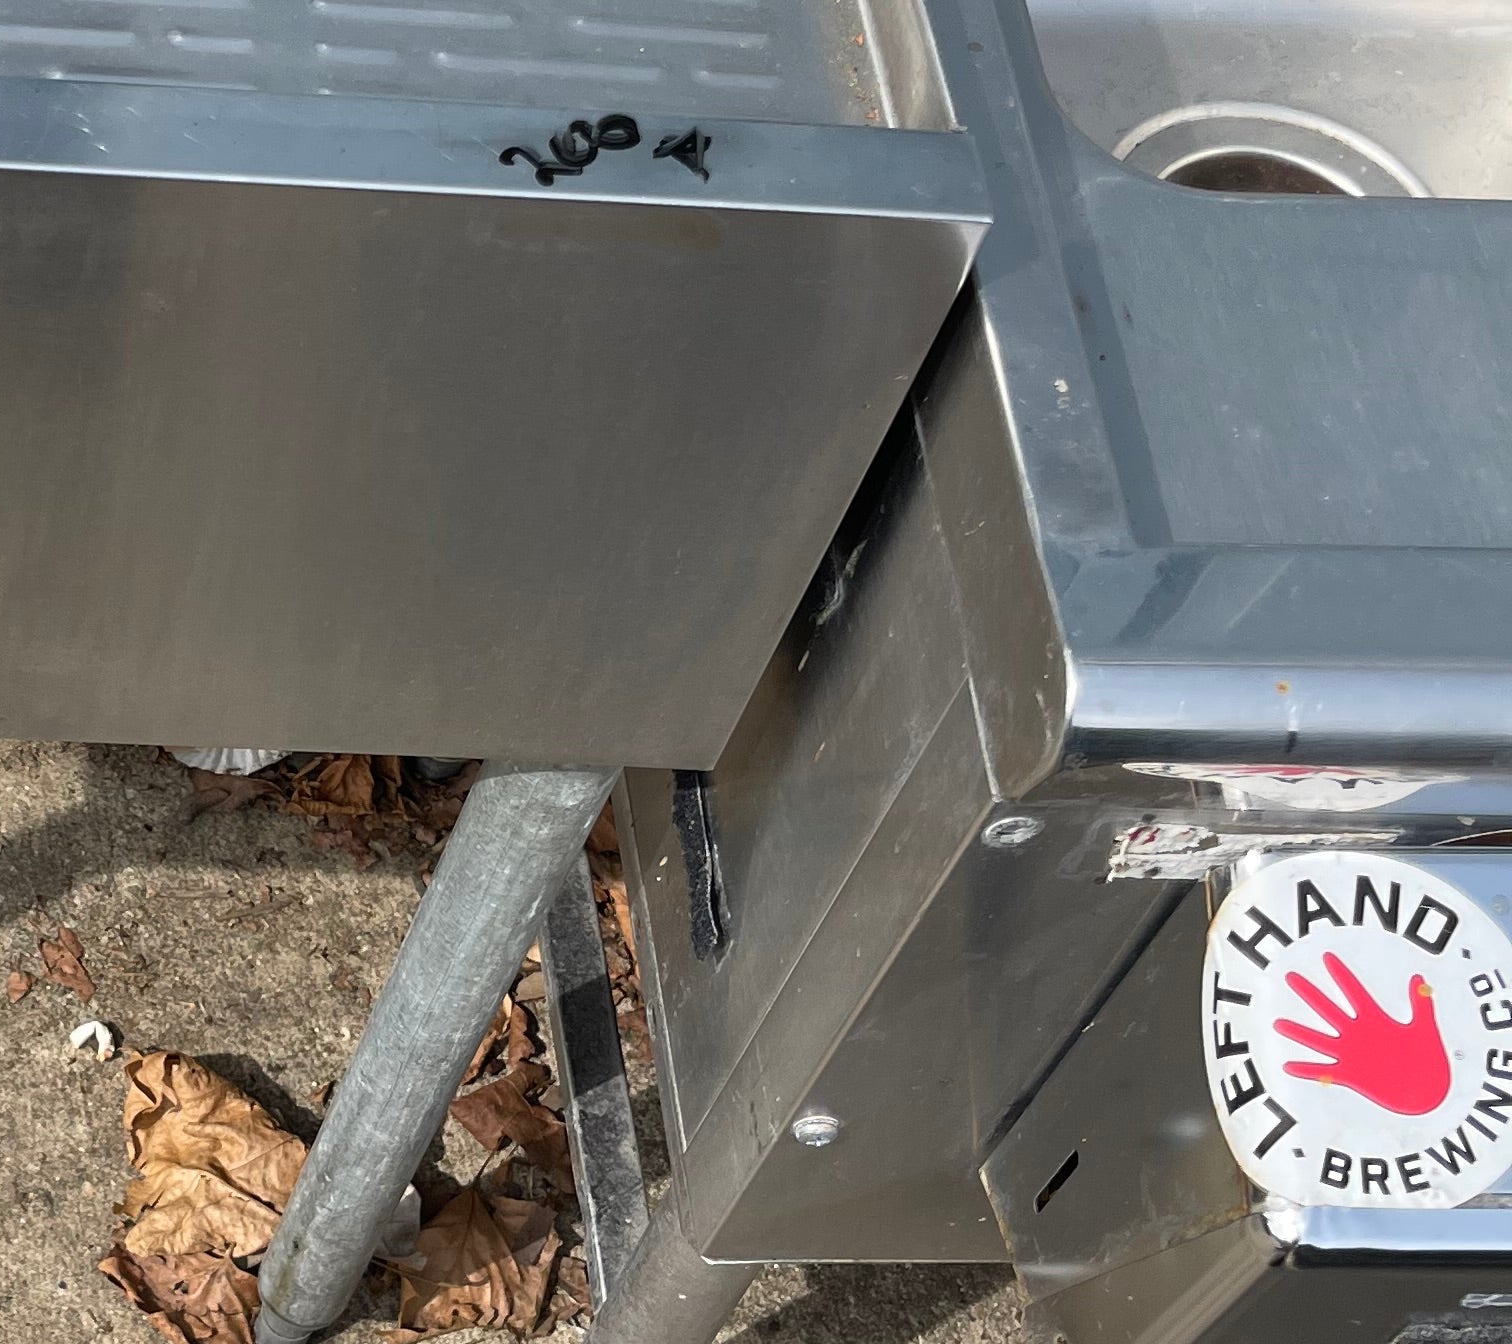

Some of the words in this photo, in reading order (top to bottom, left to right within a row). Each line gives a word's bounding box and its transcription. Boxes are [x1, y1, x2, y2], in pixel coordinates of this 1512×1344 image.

[1226, 874, 1459, 971] HAND
[1212, 971, 1297, 1159] LEFT
[1320, 1048, 1512, 1195] BREWING
